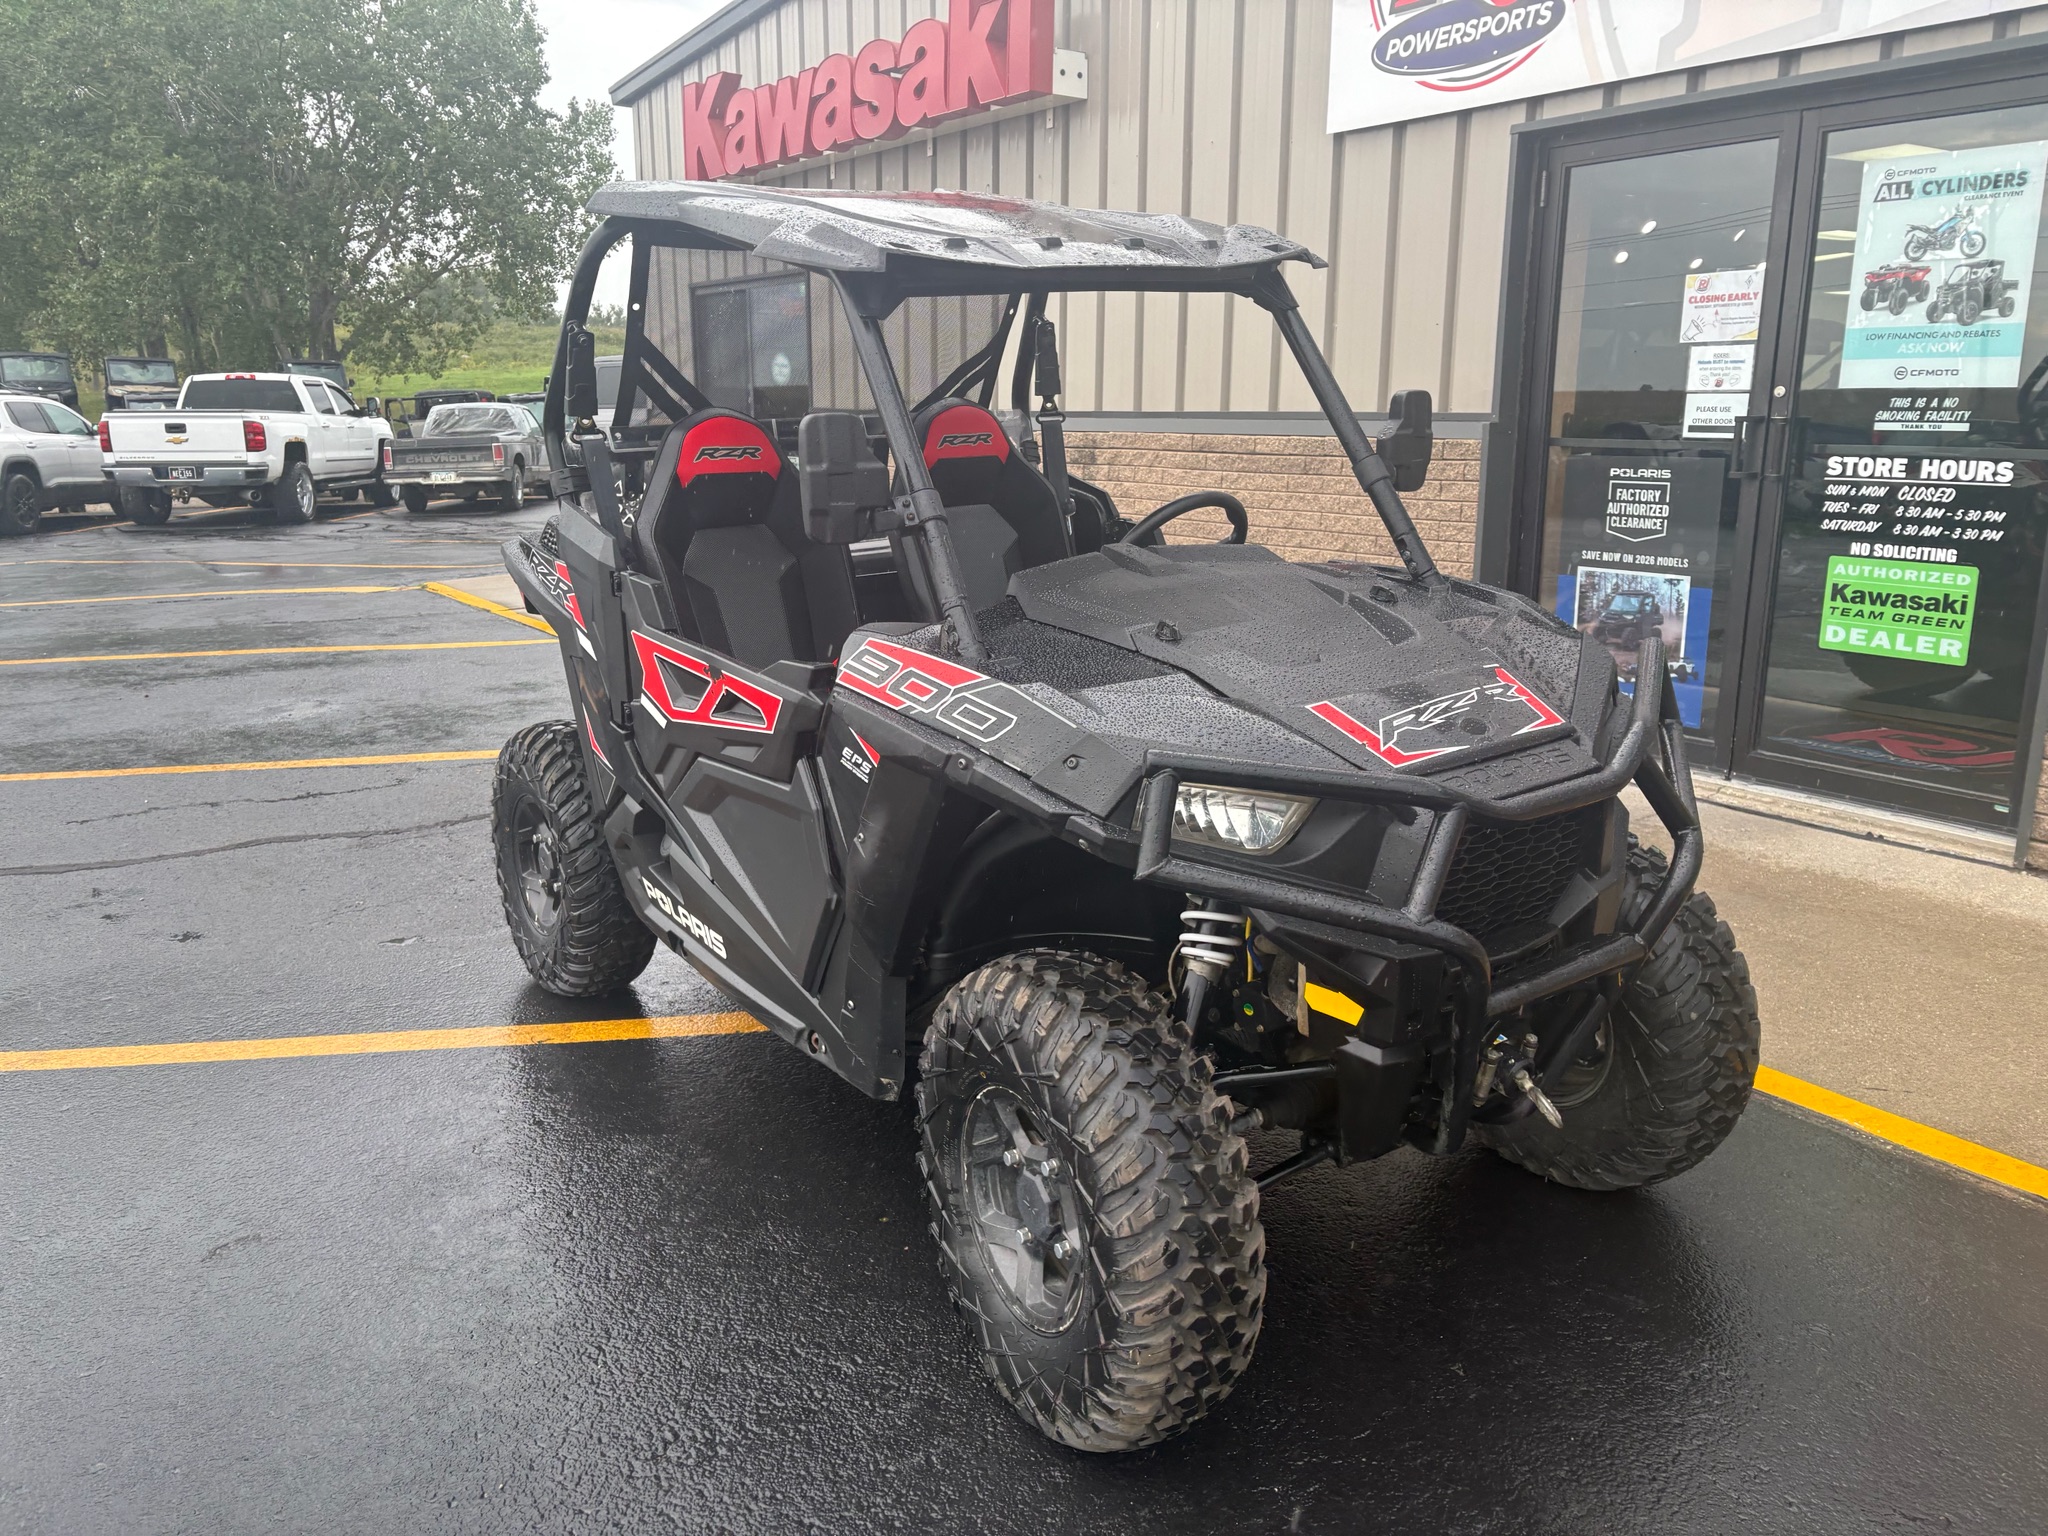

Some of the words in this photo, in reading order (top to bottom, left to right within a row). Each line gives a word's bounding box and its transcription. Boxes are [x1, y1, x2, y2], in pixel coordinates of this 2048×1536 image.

[1385, 2, 1553, 62] POWERSPORTS
[683, 0, 1053, 182] Kawasaki
[1897, 167, 1936, 177] CFMOTO
[1877, 183, 1910, 200] ALL
[1922, 170, 2028, 196] CYLINDERS
[1964, 193, 2000, 201] CLEARANCE
[2002, 190, 2024, 198] EVENT
[1688, 294, 1726, 304] CLOSING
[1727, 291, 1759, 301] EARLY
[1866, 333, 1886, 341] LOW
[1886, 331, 1939, 340] FINANCING
[1962, 329, 2001, 338] REBATES
[1897, 342, 1926, 354] ASK
[1910, 369, 1959, 377] CFMOTO
[1889, 397, 1912, 408] THIS
[1915, 397, 1926, 408] IS
[1930, 397, 1938, 408] A
[1943, 397, 1960, 408] NO
[1874, 410, 1920, 421] SMOKING
[1924, 410, 1972, 421] FACILITY
[937, 432, 993, 449] RZR
[405, 454, 480, 463] CHEVROLET
[693, 446, 763, 463] RZR
[1610, 468, 1672, 478] POLARIS
[1826, 456, 1908, 479] STORE
[1920, 459, 2015, 483] HOURS
[1616, 488, 1661, 502] FACTORY
[1825, 484, 1851, 496] SUN
[1858, 485, 1890, 497] MON
[1898, 485, 1957, 503] CLOSED
[1607, 502, 1669, 517] AUTHORIZED
[1822, 501, 1850, 513] TUES
[1858, 503, 1881, 514] FRI
[1921, 507, 1946, 519] AM
[1982, 510, 2007, 523] PM
[1611, 516, 1663, 530] CLEARANCE
[1820, 518, 1883, 533] SATURDAY
[1919, 525, 1943, 537] AM
[1979, 529, 2005, 542] PM
[1582, 550, 1601, 560] SAVE
[1602, 552, 1621, 562] NOW
[1622, 554, 1634, 563] ON
[1635, 555, 1655, 565] 2026
[1657, 557, 1689, 568] MODELS
[1850, 542, 1871, 556] NO
[1873, 544, 1958, 563] SOLICITING
[1834, 563, 1971, 586] AUTHORIZED
[1830, 583, 1969, 615] Kawasaki
[1829, 606, 1885, 620] TEAM
[1891, 613, 1965, 629] GREEN
[1825, 624, 1963, 658] DEALER
[839, 646, 1018, 743] 900
[842, 746, 872, 774] EPS
[642, 876, 727, 960] POLARIS
